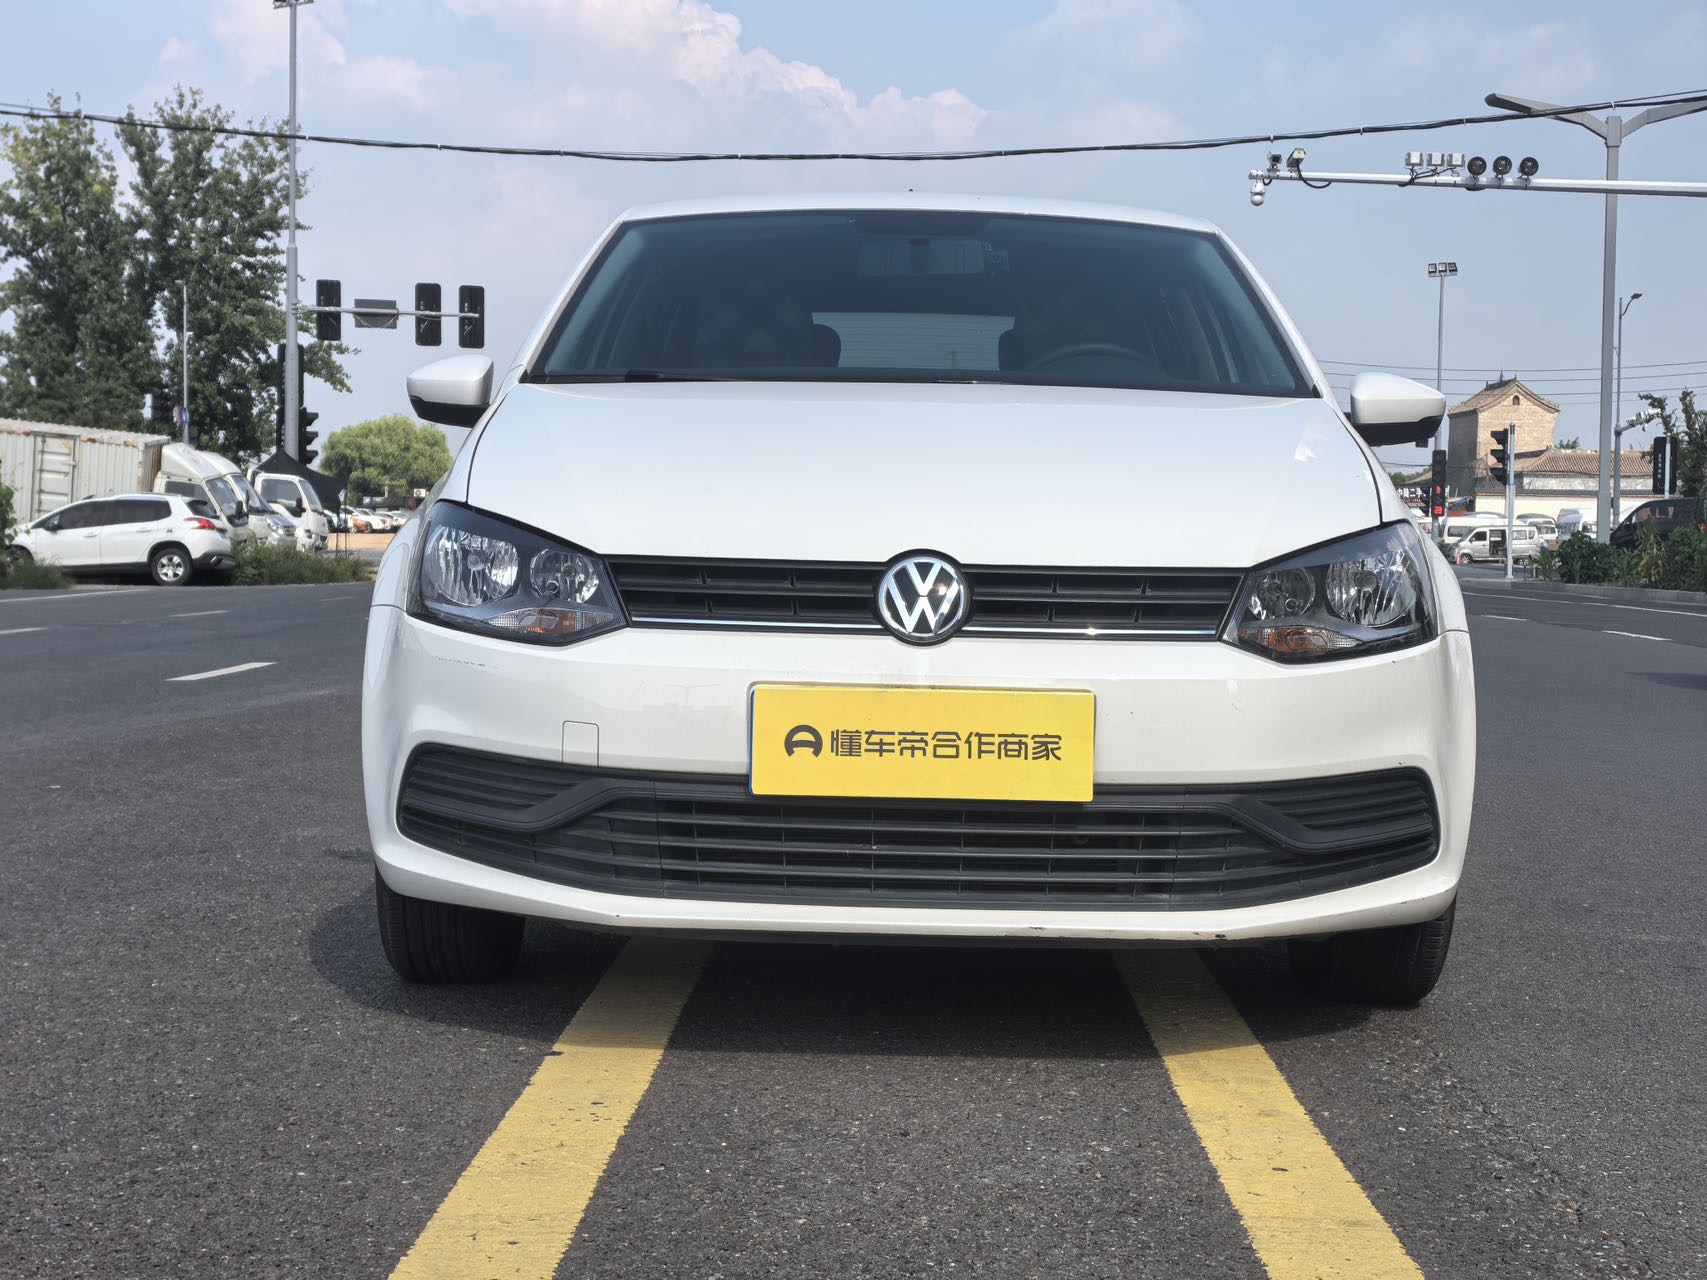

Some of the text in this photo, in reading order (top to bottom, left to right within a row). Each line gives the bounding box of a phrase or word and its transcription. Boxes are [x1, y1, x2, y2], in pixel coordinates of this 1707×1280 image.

[830, 729, 1062, 761] 懂车帝合作商家
